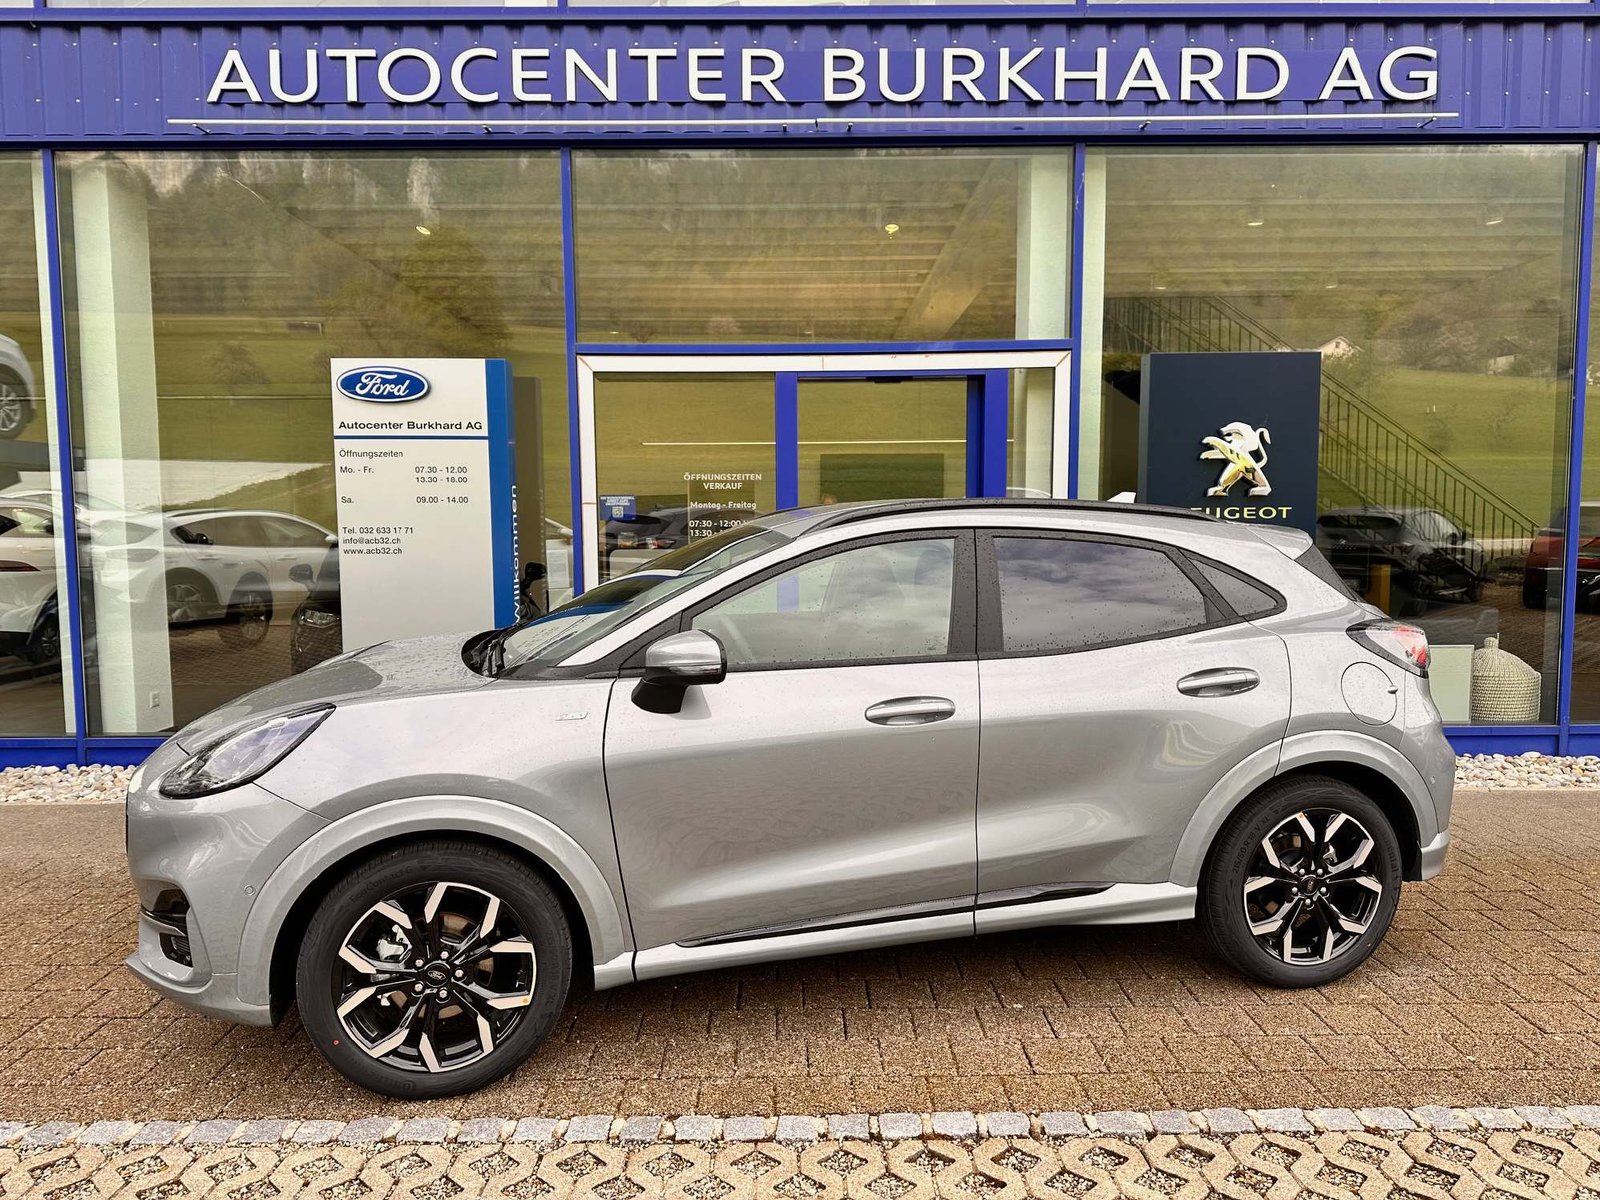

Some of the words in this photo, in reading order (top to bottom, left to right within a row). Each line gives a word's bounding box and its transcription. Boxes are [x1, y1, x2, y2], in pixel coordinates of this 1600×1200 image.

[207, 47, 787, 105] AUTOCENTER
[822, 46, 1293, 104] BURKHARD
[1319, 45, 1440, 101] AG
[355, 372, 411, 397] Ford
[338, 421, 404, 431] Autocenter
[407, 421, 463, 431] Burkhard
[465, 421, 483, 431] AG
[339, 449, 404, 459] Öffnungszeiten
[339, 466, 356, 474] Mo.
[363, 466, 375, 474] Fr.
[415, 466, 438, 474] 07.30
[445, 466, 468, 474] 12.00
[416, 476, 438, 484] 13.30
[446, 476, 468, 484] 18.00
[683, 472, 762, 482] ÖFFNUNGSZEITEN
[703, 482, 743, 490] VERKAUF
[340, 496, 355, 505] Sa.
[416, 496, 439, 504] 09.00
[447, 496, 469, 504] 14.00
[690, 501, 721, 510] Montag
[728, 501, 757, 510] Freitag
[1190, 506, 1293, 519] UGEOT
[689, 520, 712, 528] 07:30
[342, 526, 357, 535] Tel.
[359, 526, 374, 535] 032
[376, 526, 391, 535] 633
[404, 526, 414, 535] 71
[690, 529, 712, 537] 13:30
[342, 536, 401, 545] info@acb32.ch
[343, 547, 403, 555] www.acb32.ch
